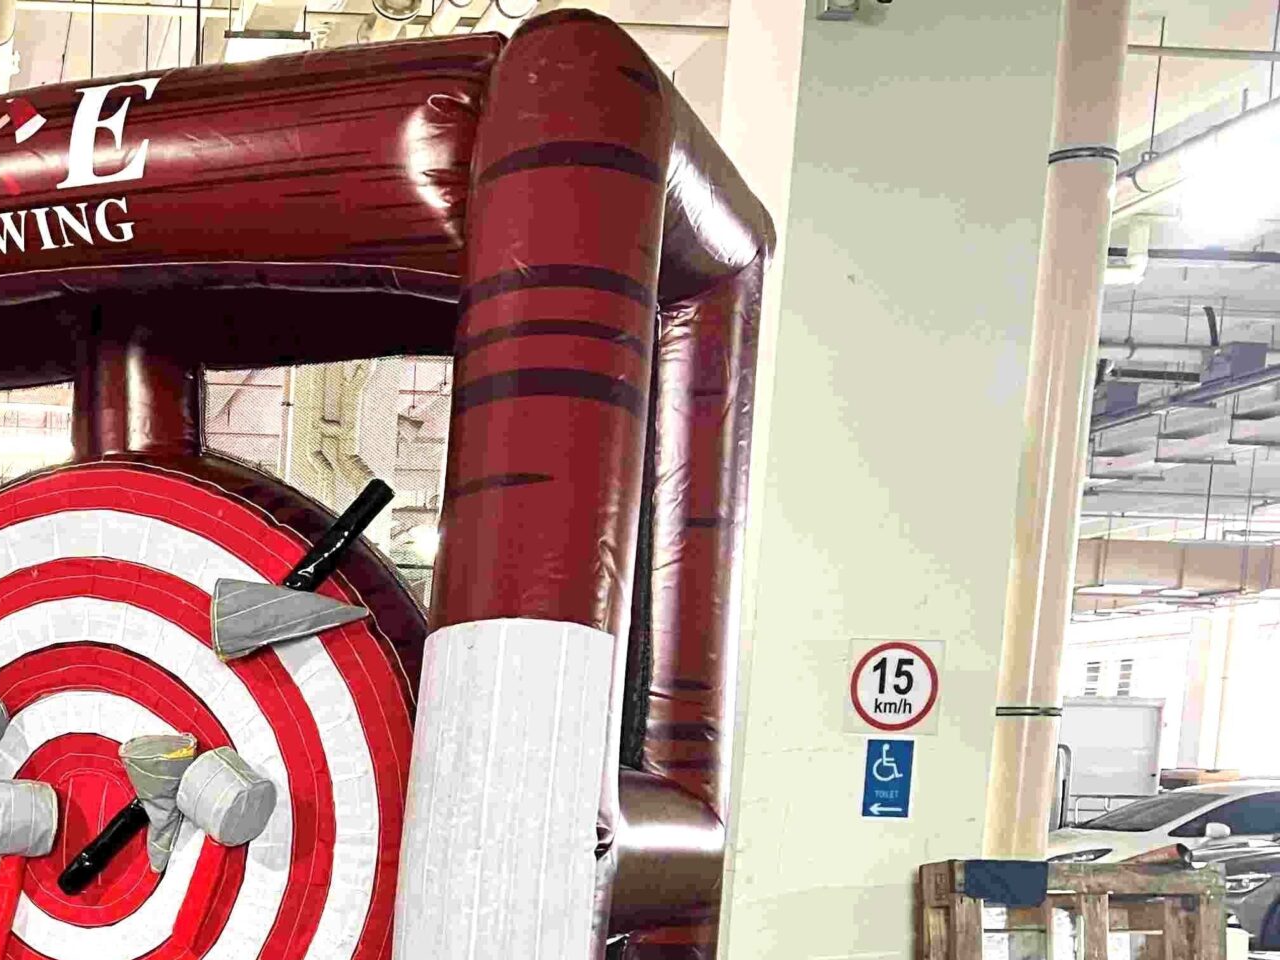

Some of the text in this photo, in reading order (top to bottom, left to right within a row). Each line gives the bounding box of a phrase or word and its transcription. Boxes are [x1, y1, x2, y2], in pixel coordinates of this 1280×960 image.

[873, 657, 914, 695] 15
[874, 698, 912, 714] km/h
[874, 790, 899, 798] TOILET
